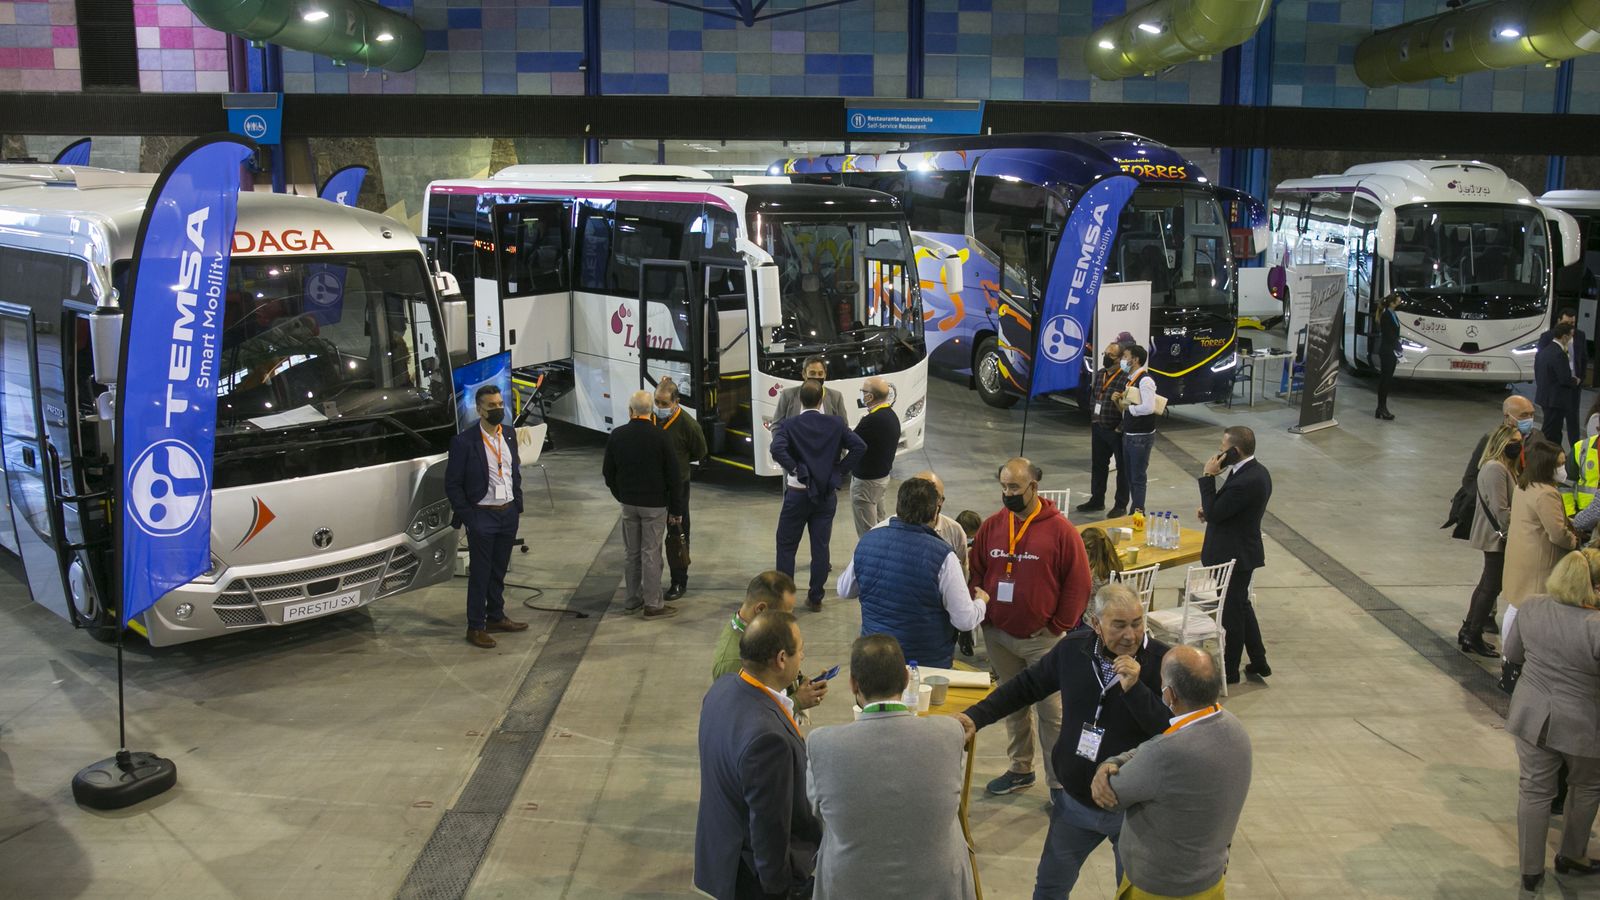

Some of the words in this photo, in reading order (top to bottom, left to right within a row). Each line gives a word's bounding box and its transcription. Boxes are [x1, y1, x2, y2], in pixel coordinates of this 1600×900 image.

[1120, 164, 1187, 179] TORRES
[1065, 203, 1110, 310] TEMSA
[1086, 268, 1100, 296] Smart
[1095, 227, 1113, 265] Mobility
[165, 206, 210, 428] TEMSA
[1111, 303, 1129, 313] Irizar
[197, 333, 215, 389] Smart
[289, 599, 338, 618] PRESTIJ
[341, 594, 356, 606] SX
